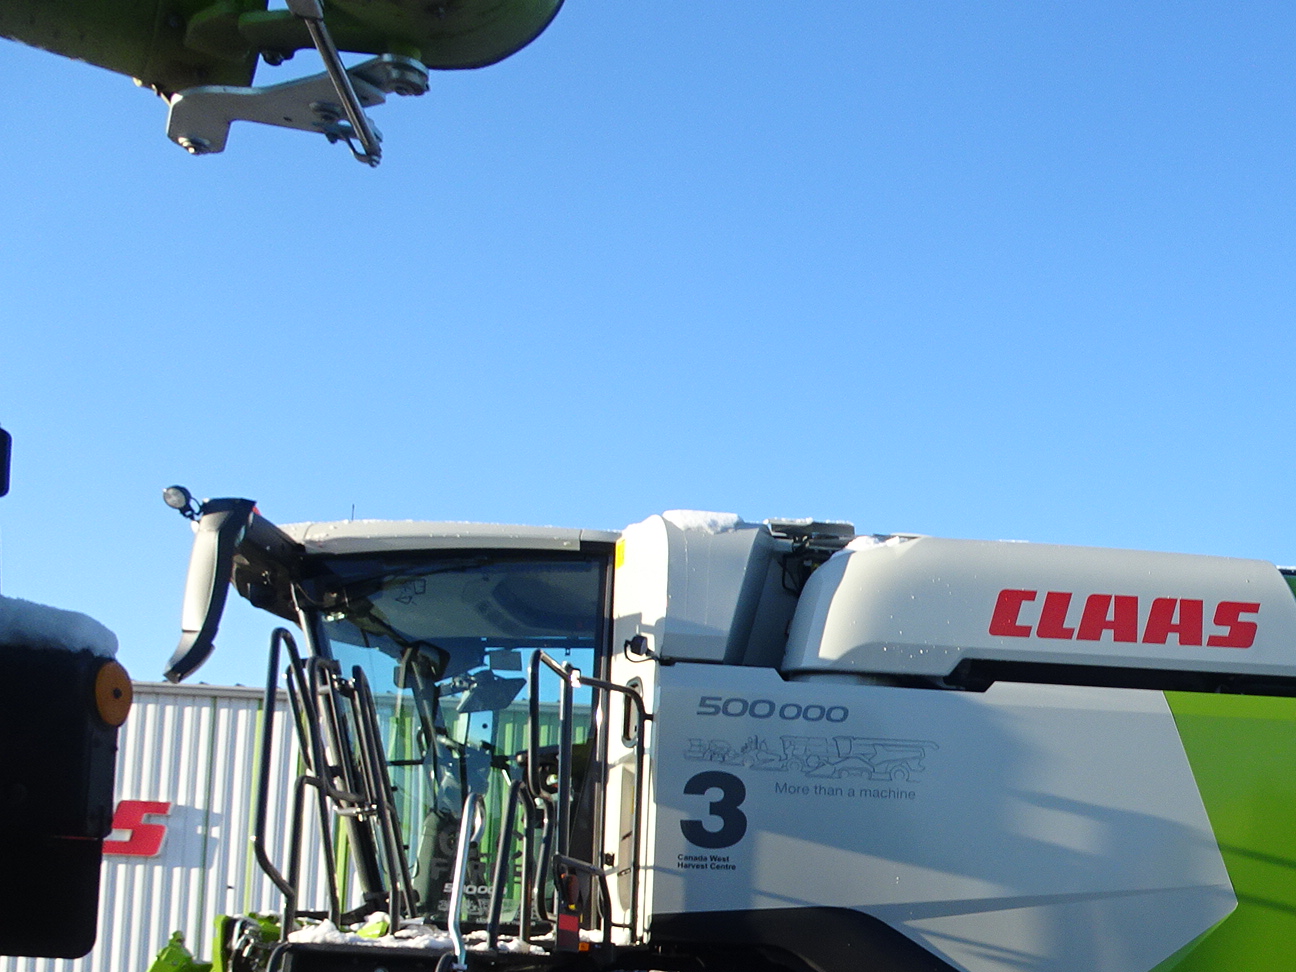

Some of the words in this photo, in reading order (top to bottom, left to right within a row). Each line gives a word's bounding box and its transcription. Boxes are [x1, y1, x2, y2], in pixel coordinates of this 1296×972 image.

[988, 588, 1261, 649] CLAAS
[774, 781, 810, 796] More
[814, 784, 843, 797] than
[847, 787, 856, 798] a
[859, 788, 916, 800] machine
[680, 770, 748, 849] 3
[677, 853, 708, 862] Canada
[709, 854, 730, 863] West
[677, 861, 708, 870] Harvest
[709, 862, 737, 871] Centre
